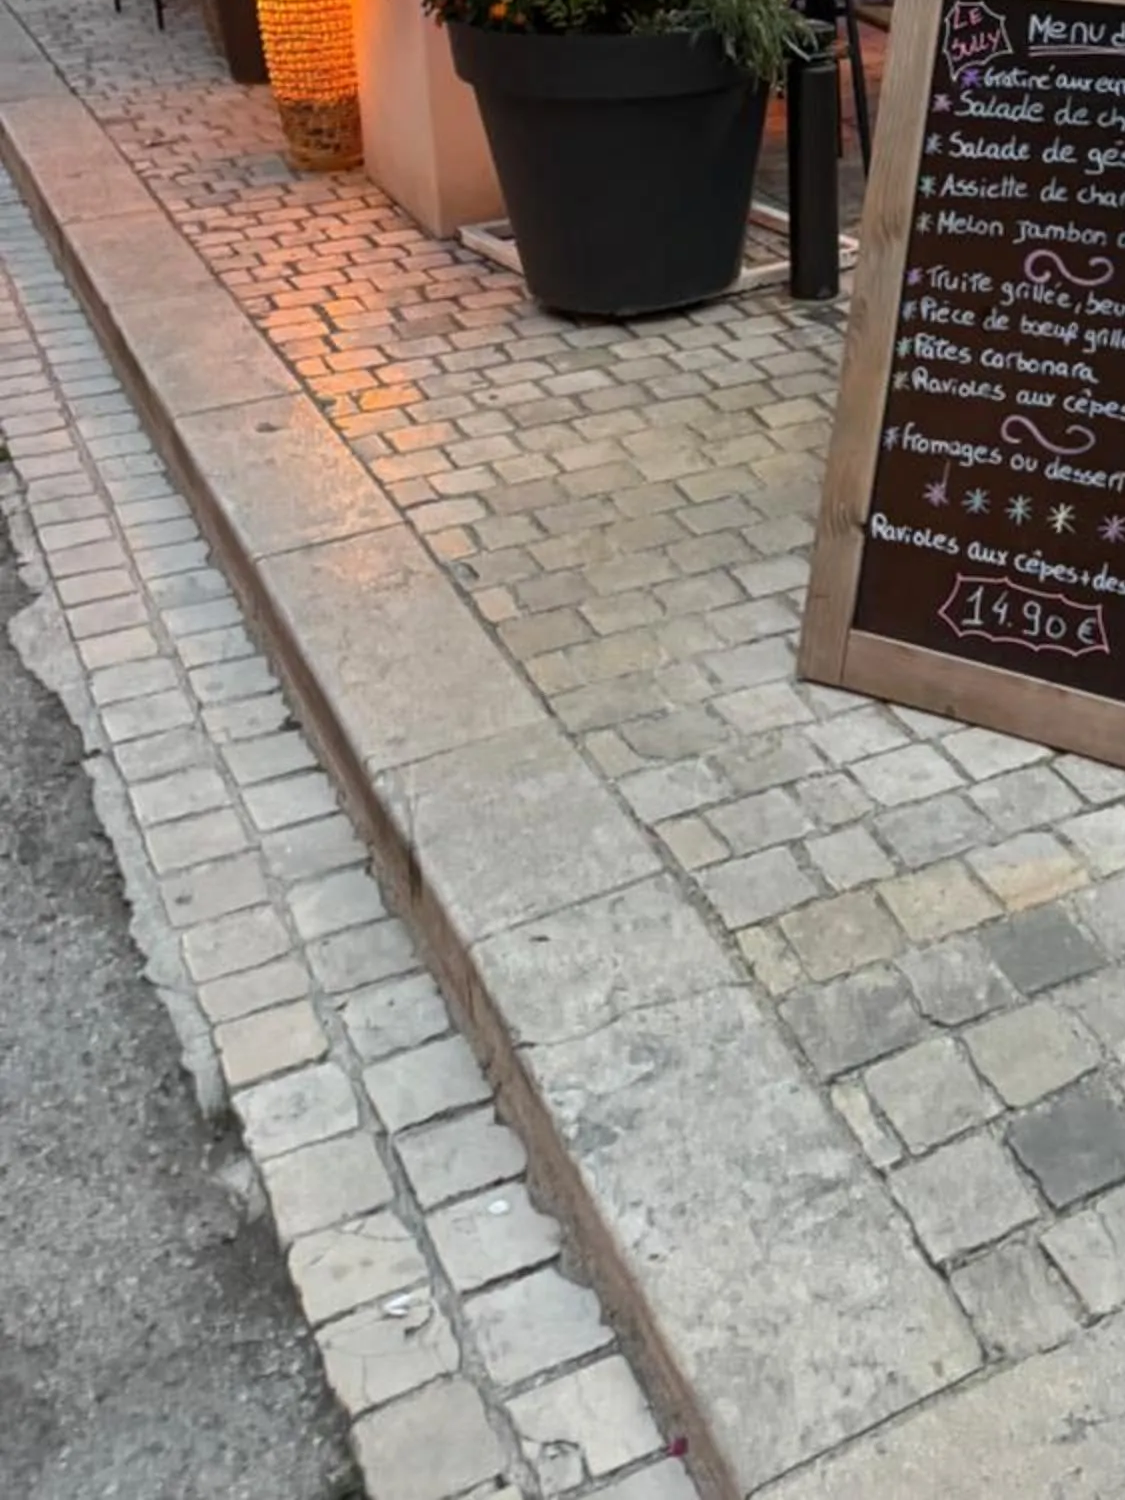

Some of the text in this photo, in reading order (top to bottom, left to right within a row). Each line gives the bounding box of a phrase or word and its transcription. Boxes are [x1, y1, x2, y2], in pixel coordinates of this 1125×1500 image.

[953, 6, 984, 30] LE
[1028, 13, 1106, 44] Menu
[954, 90, 1045, 122] Salade
[1054, 95, 1092, 126] de
[948, 130, 1031, 160] Salade
[1042, 135, 1078, 164] de
[938, 172, 1029, 199] Assiette
[1040, 176, 1069, 203] de
[936, 209, 1004, 237] Melon
[926, 264, 995, 293] Truite
[982, 306, 1011, 331] de
[979, 347, 1100, 384] carbonara
[910, 365, 1007, 402] Ravioles
[1015, 389, 1057, 408] aux
[1009, 452, 1039, 472] ou
[870, 511, 960, 555] Ravioles
[967, 540, 1009, 567] aux
